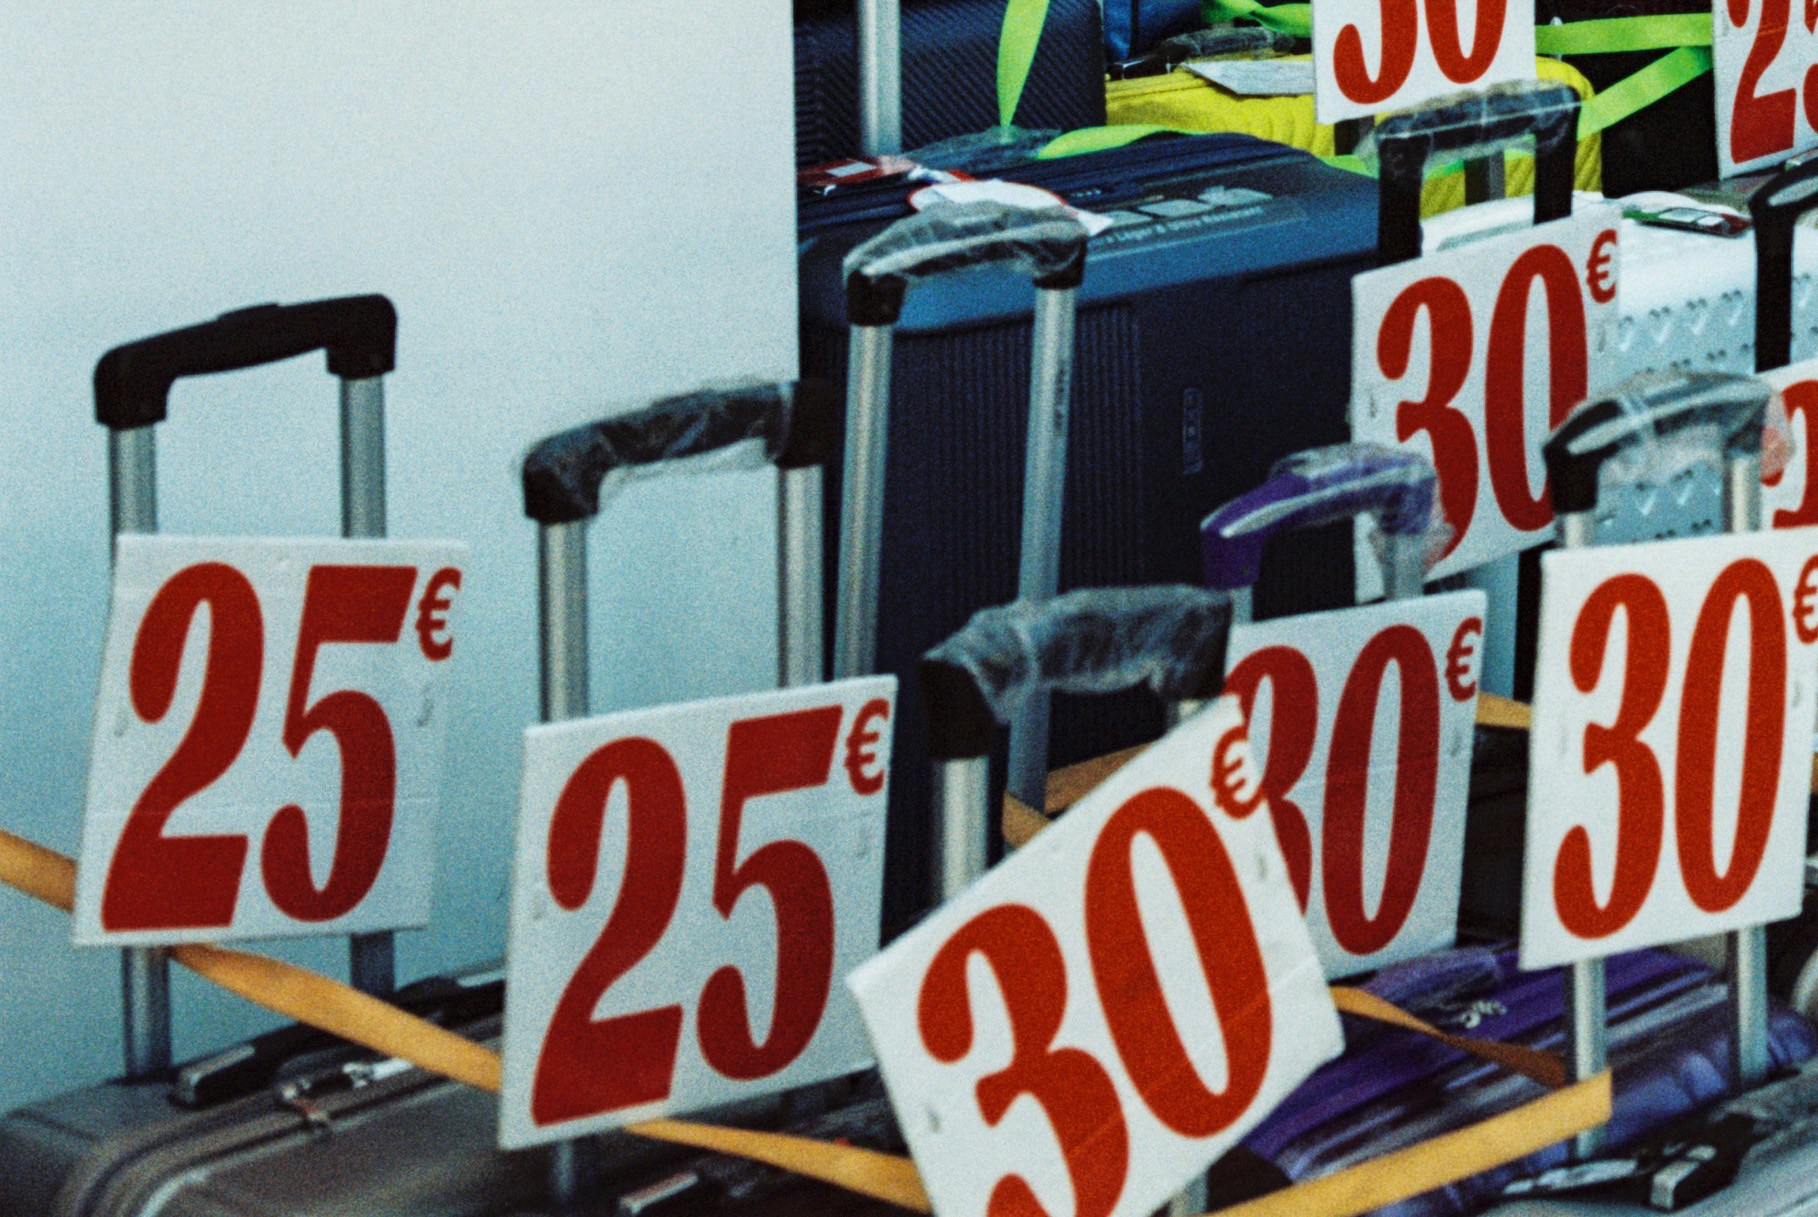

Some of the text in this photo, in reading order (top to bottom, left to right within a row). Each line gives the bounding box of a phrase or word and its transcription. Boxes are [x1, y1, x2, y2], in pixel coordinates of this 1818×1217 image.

[1377, 229, 1617, 560] 30€
[101, 561, 462, 931] 25€
[530, 698, 888, 1127] 25€
[1225, 617, 1482, 955] 30€
[917, 725, 1273, 1217] 30€
